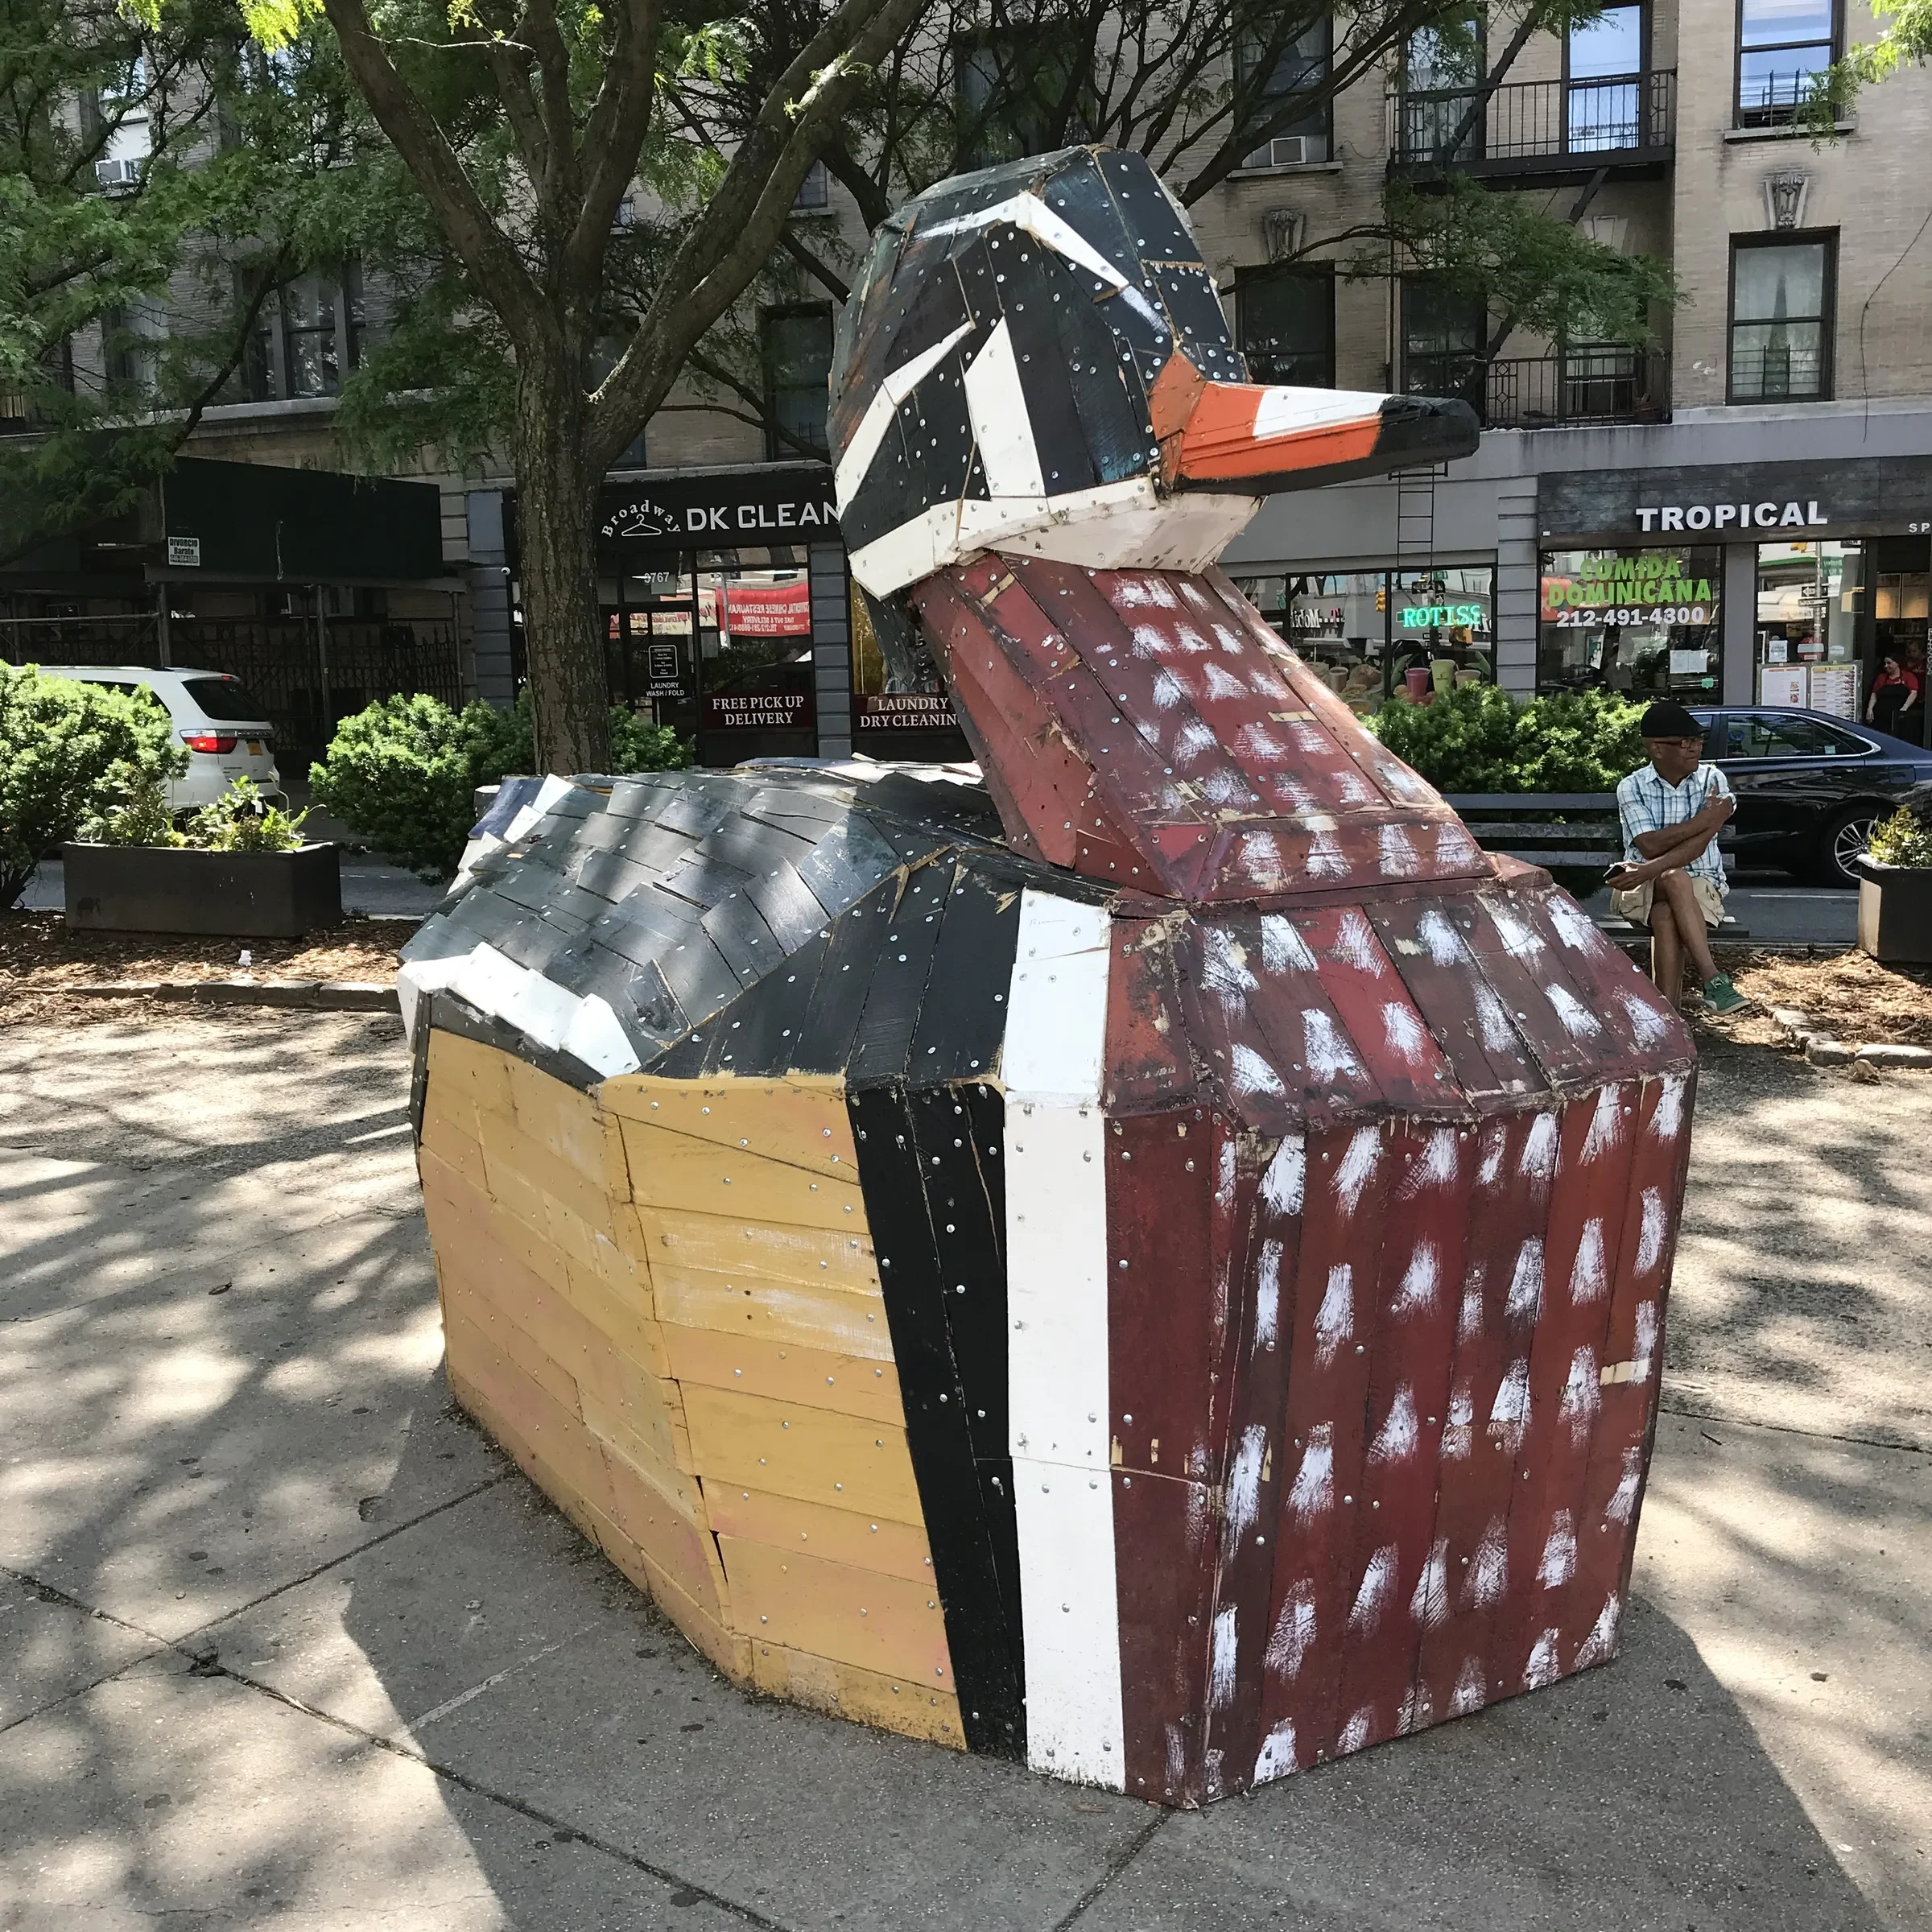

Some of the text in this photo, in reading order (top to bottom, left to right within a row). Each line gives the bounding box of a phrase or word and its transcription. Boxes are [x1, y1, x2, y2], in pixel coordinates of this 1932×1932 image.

[601, 499, 680, 537] Broadway
[687, 506, 730, 531] DK
[1636, 501, 1828, 532] TROPICAL
[1580, 555, 1681, 581] COMIDA
[1549, 578, 1711, 607] DOMINICANA
[1556, 606, 1704, 628] 212-491-4300
[712, 696, 804, 710] FREE PICK UP
[877, 697, 949, 711] LAUNDRY
[724, 712, 794, 725] DELIVERY
[860, 713, 960, 728] DRY CLEANIN
